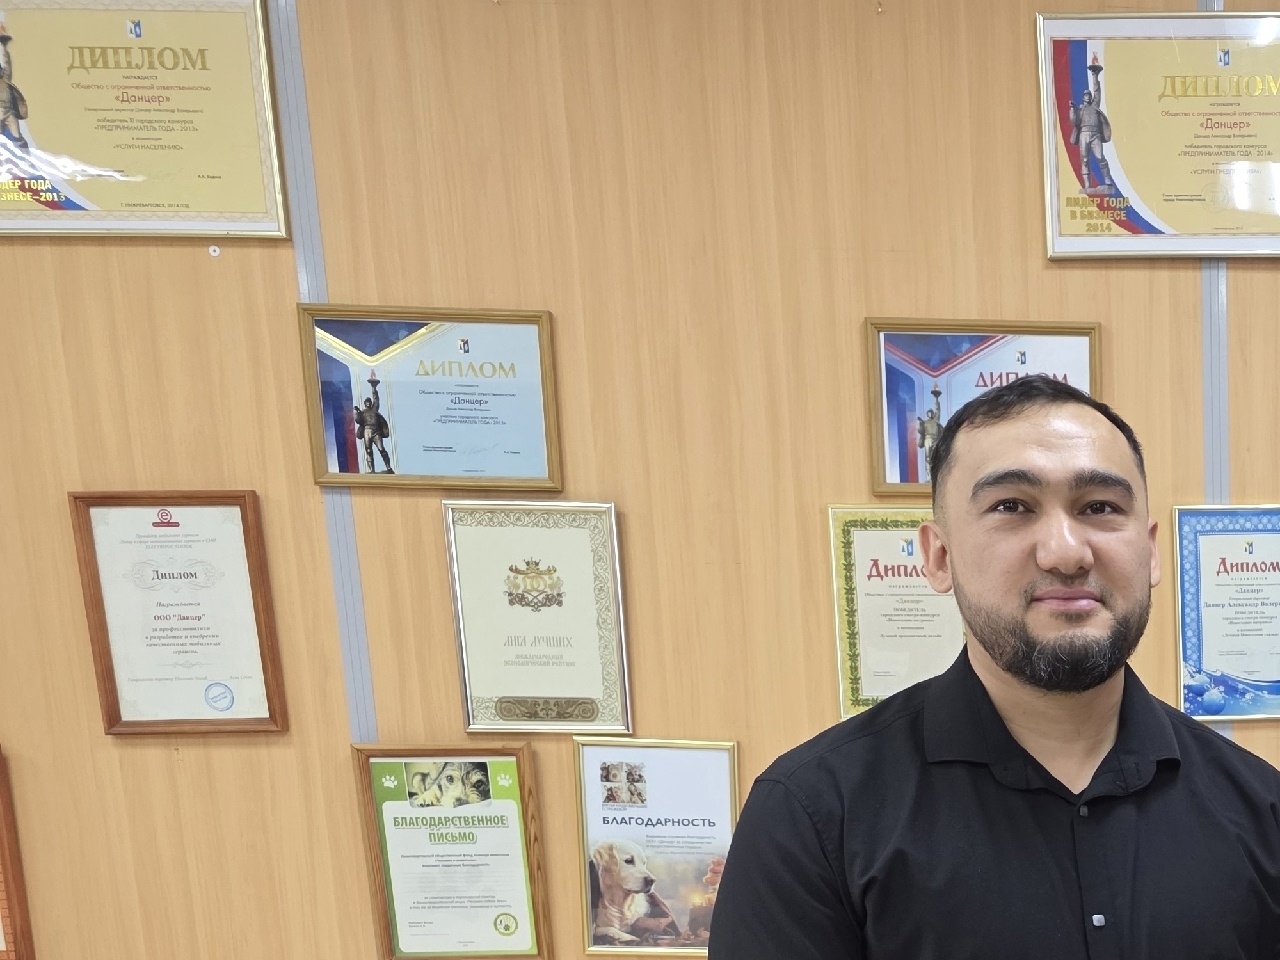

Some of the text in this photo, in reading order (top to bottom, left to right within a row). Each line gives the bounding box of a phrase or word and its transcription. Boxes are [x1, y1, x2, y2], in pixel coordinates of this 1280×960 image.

[66, 46, 211, 75] ДИПЛОМ
[114, 91, 171, 106] «Данцер»
[1199, 117, 1252, 131] «Данцер»
[24, 180, 52, 190] ГОДА
[1104, 197, 1131, 207] ГОДА
[1080, 210, 1127, 220] БИЗНЕСЕ
[1086, 222, 1112, 232] 2014
[415, 359, 517, 379] ДИПЛОМ
[974, 371, 1069, 387] ДИПМ
[152, 570, 198, 581] Диплом
[393, 814, 508, 830] БЛАГОДАРСТВЕННОЕ
[602, 816, 717, 828] БЛАГОДАРНОСТЬ
[428, 831, 476, 843] ПИСЬМО
